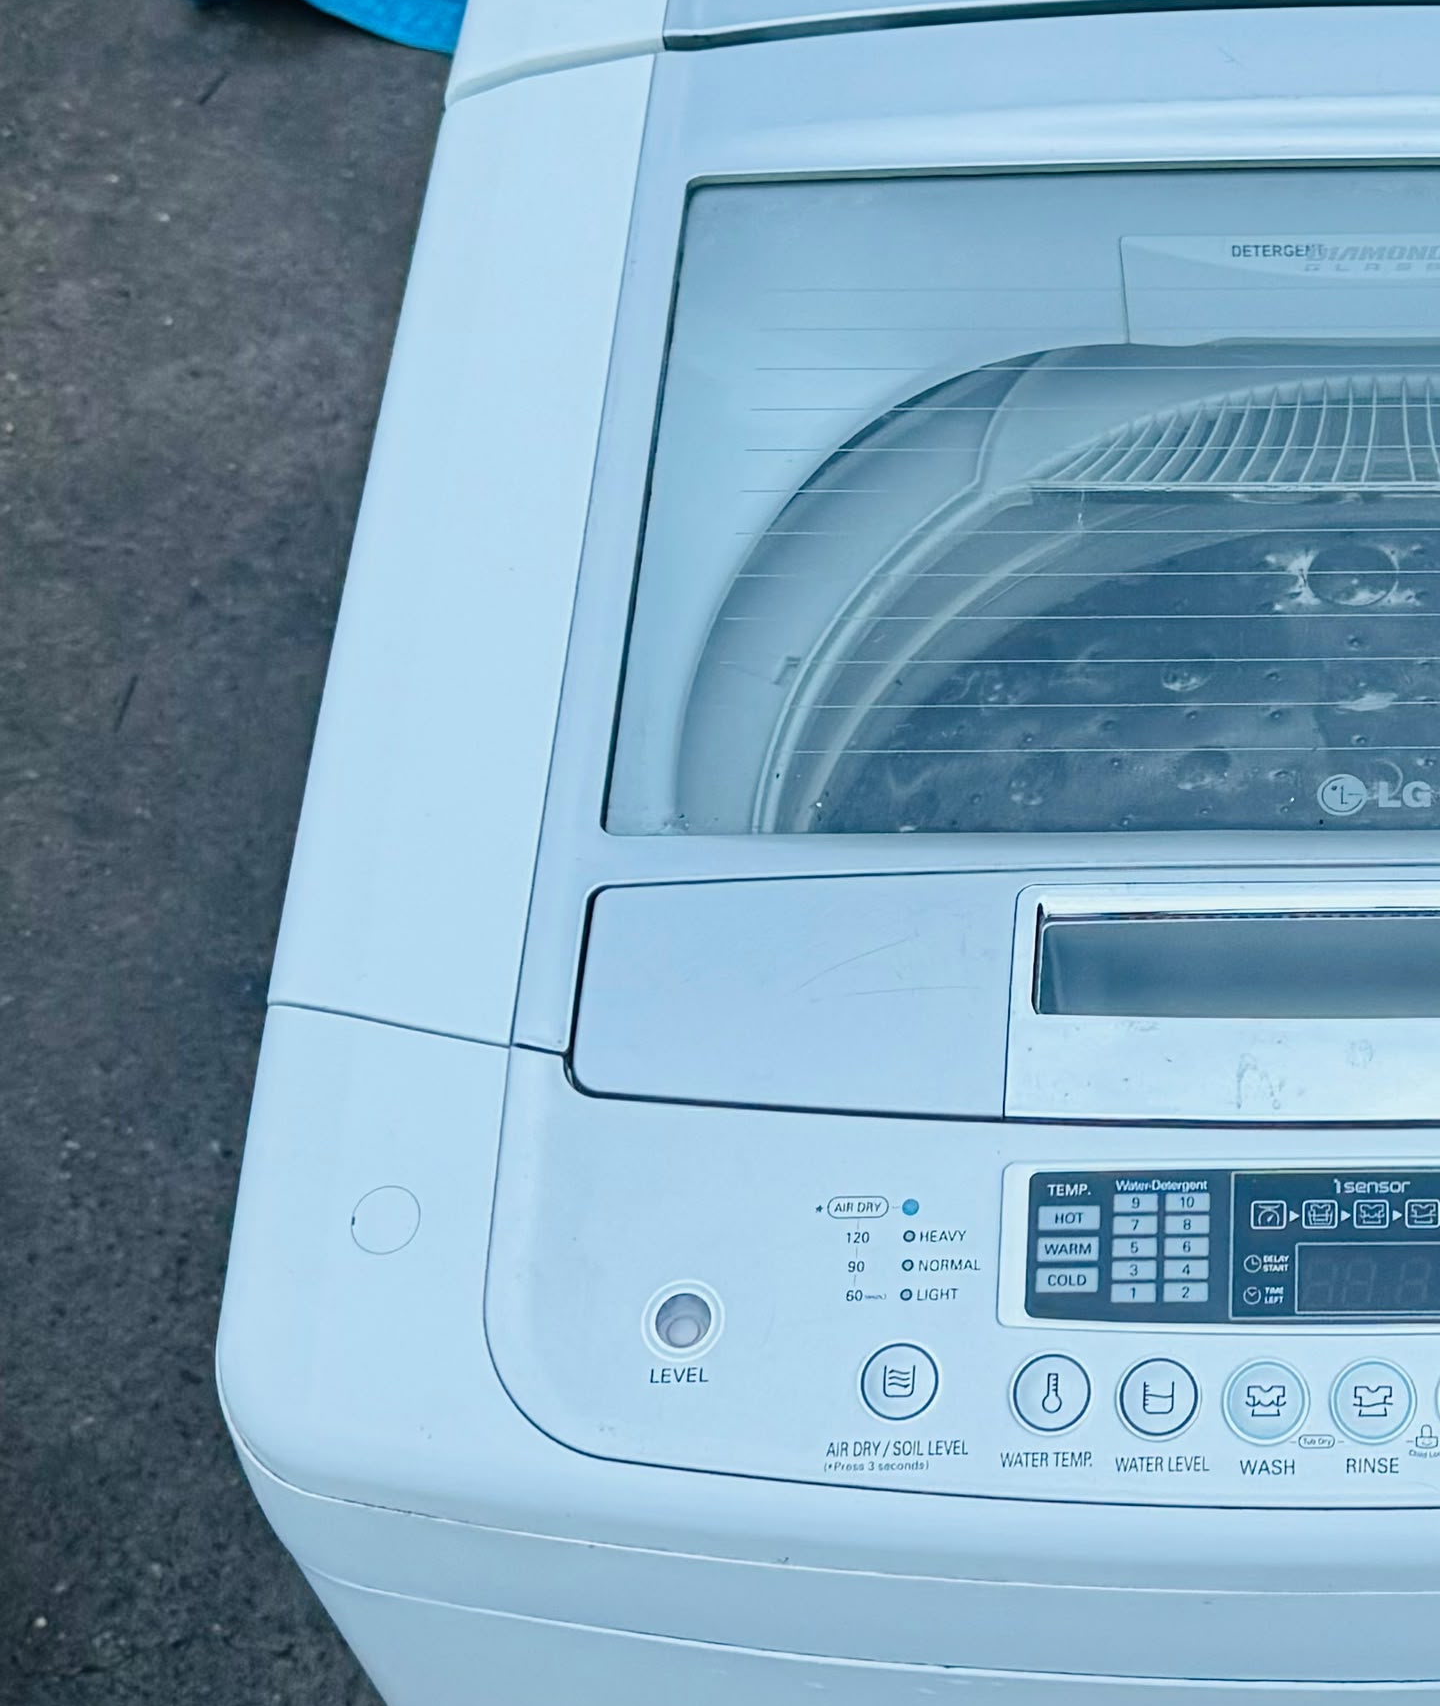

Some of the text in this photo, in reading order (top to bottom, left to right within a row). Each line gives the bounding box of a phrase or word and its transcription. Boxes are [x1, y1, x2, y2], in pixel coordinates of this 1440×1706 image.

[1231, 244, 1324, 257] DETERGENT
[1378, 781, 1432, 808] LG
[1047, 1183, 1091, 1197] TEMP.
[834, 1201, 882, 1213] AIR DRY
[1131, 1197, 1140, 1210] 9
[1181, 1196, 1195, 1209] 10
[1054, 1212, 1084, 1225] HOT
[1183, 1218, 1191, 1231] 8
[1130, 1219, 1139, 1232] 7
[846, 1231, 870, 1244] 120
[919, 1229, 966, 1243] HEAVY
[1044, 1242, 1092, 1256] WARM
[1130, 1242, 1139, 1254] 5
[1182, 1241, 1191, 1254] 6
[918, 1259, 981, 1272] NORMAL
[1263, 1255, 1289, 1263] DELAY
[847, 1260, 865, 1273] 90
[1129, 1264, 1138, 1277] 3
[1182, 1263, 1191, 1276] 4
[1263, 1264, 1288, 1272] START
[1047, 1273, 1087, 1287] COLD
[846, 1290, 863, 1302] 60
[917, 1288, 959, 1301] LIGHT
[1131, 1287, 1136, 1300] 1
[1181, 1286, 1190, 1299] 2
[1264, 1296, 1284, 1304] LEFT
[649, 1367, 709, 1384] LEVEL
[826, 1442, 848, 1457] AIR
[853, 1441, 882, 1457] DRY
[893, 1440, 924, 1456] SOIL
[928, 1440, 968, 1456] LEVEL
[868, 1461, 875, 1471] 3
[1000, 1452, 1093, 1468] WATER TEMP.
[1115, 1456, 1210, 1473] WATER LEVEL
[1346, 1457, 1399, 1474] RINSE
[1240, 1459, 1295, 1475] WASH
